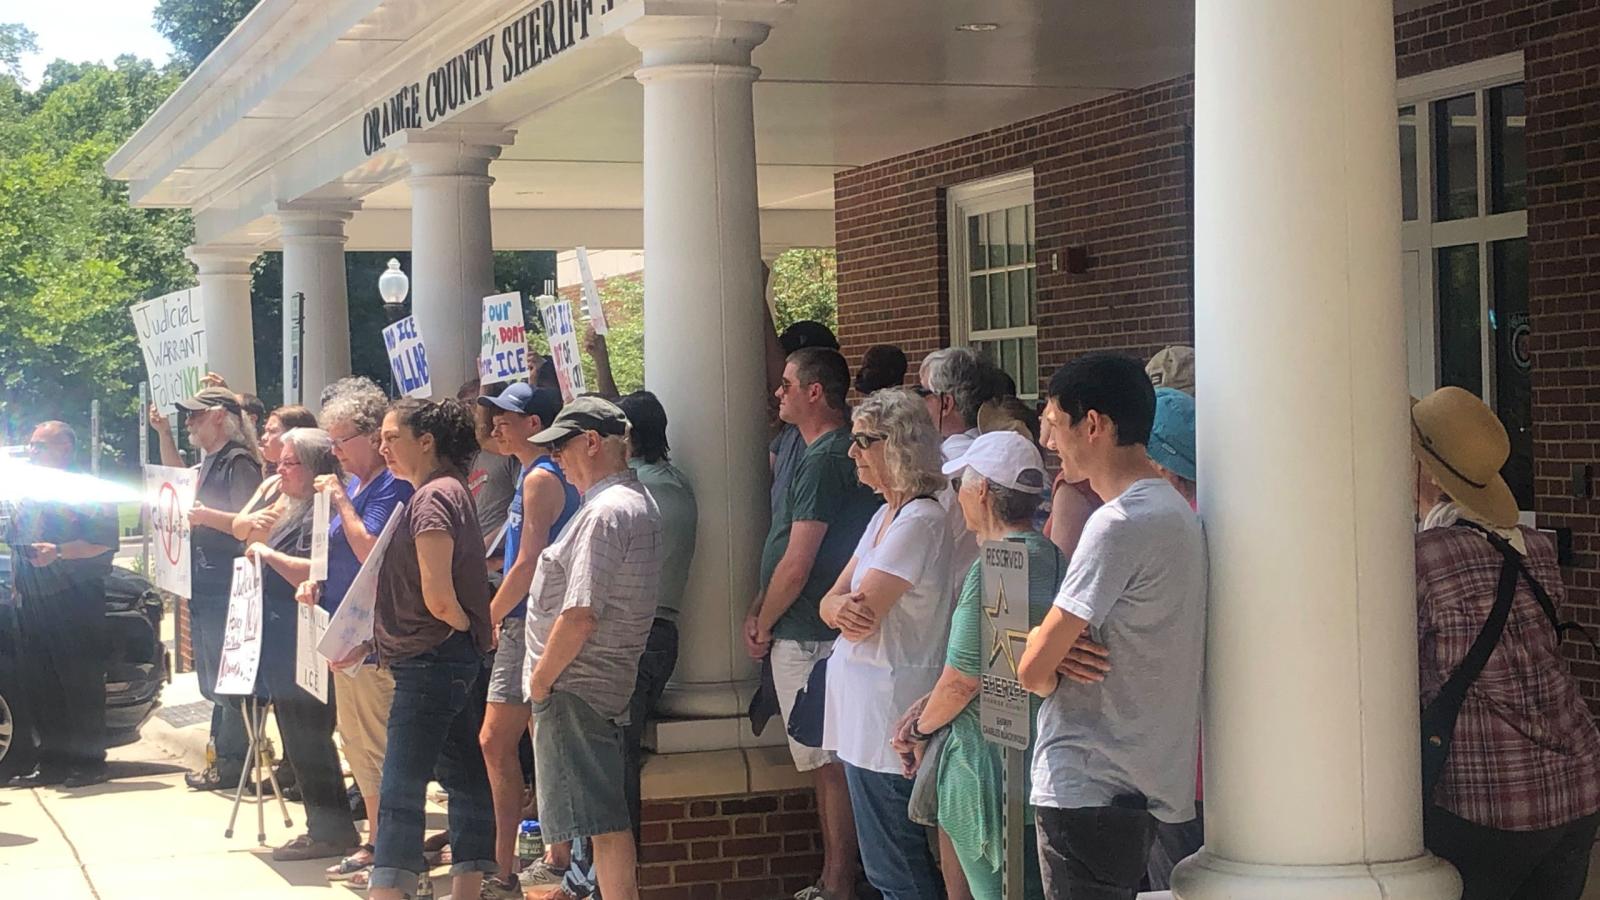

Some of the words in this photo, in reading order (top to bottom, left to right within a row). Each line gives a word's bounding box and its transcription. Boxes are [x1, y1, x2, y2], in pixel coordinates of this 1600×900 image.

[363, 82, 422, 156] ORANGE
[426, 34, 495, 122] COUNTY
[147, 330, 205, 368] WARRANT
[986, 548, 1024, 570] RESERVED
